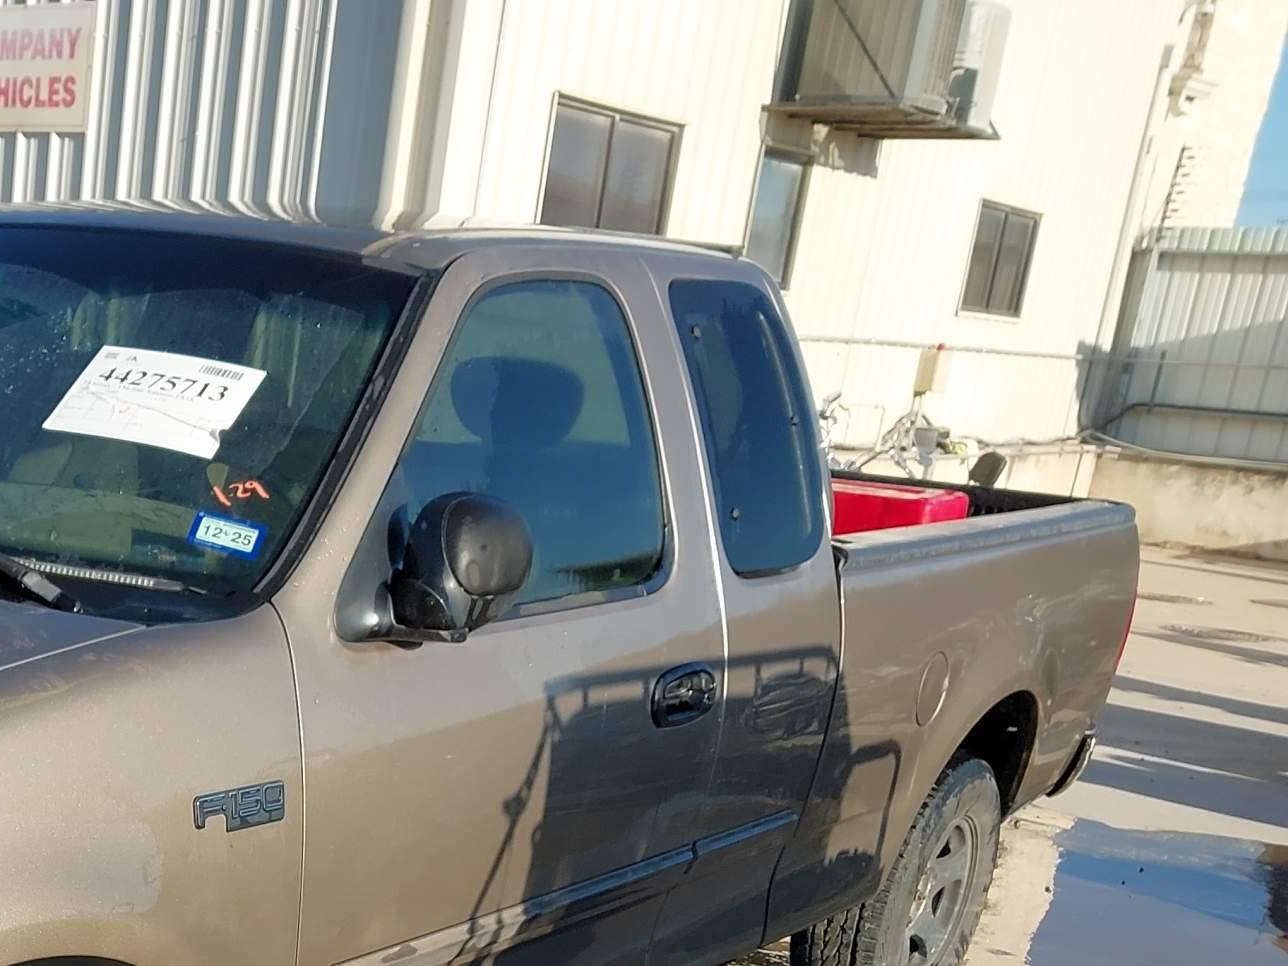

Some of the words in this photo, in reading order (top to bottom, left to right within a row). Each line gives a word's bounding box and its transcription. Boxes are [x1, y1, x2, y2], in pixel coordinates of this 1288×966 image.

[98, 367, 229, 402] 44275713
[203, 525, 223, 539] 12
[231, 531, 252, 547] 25
